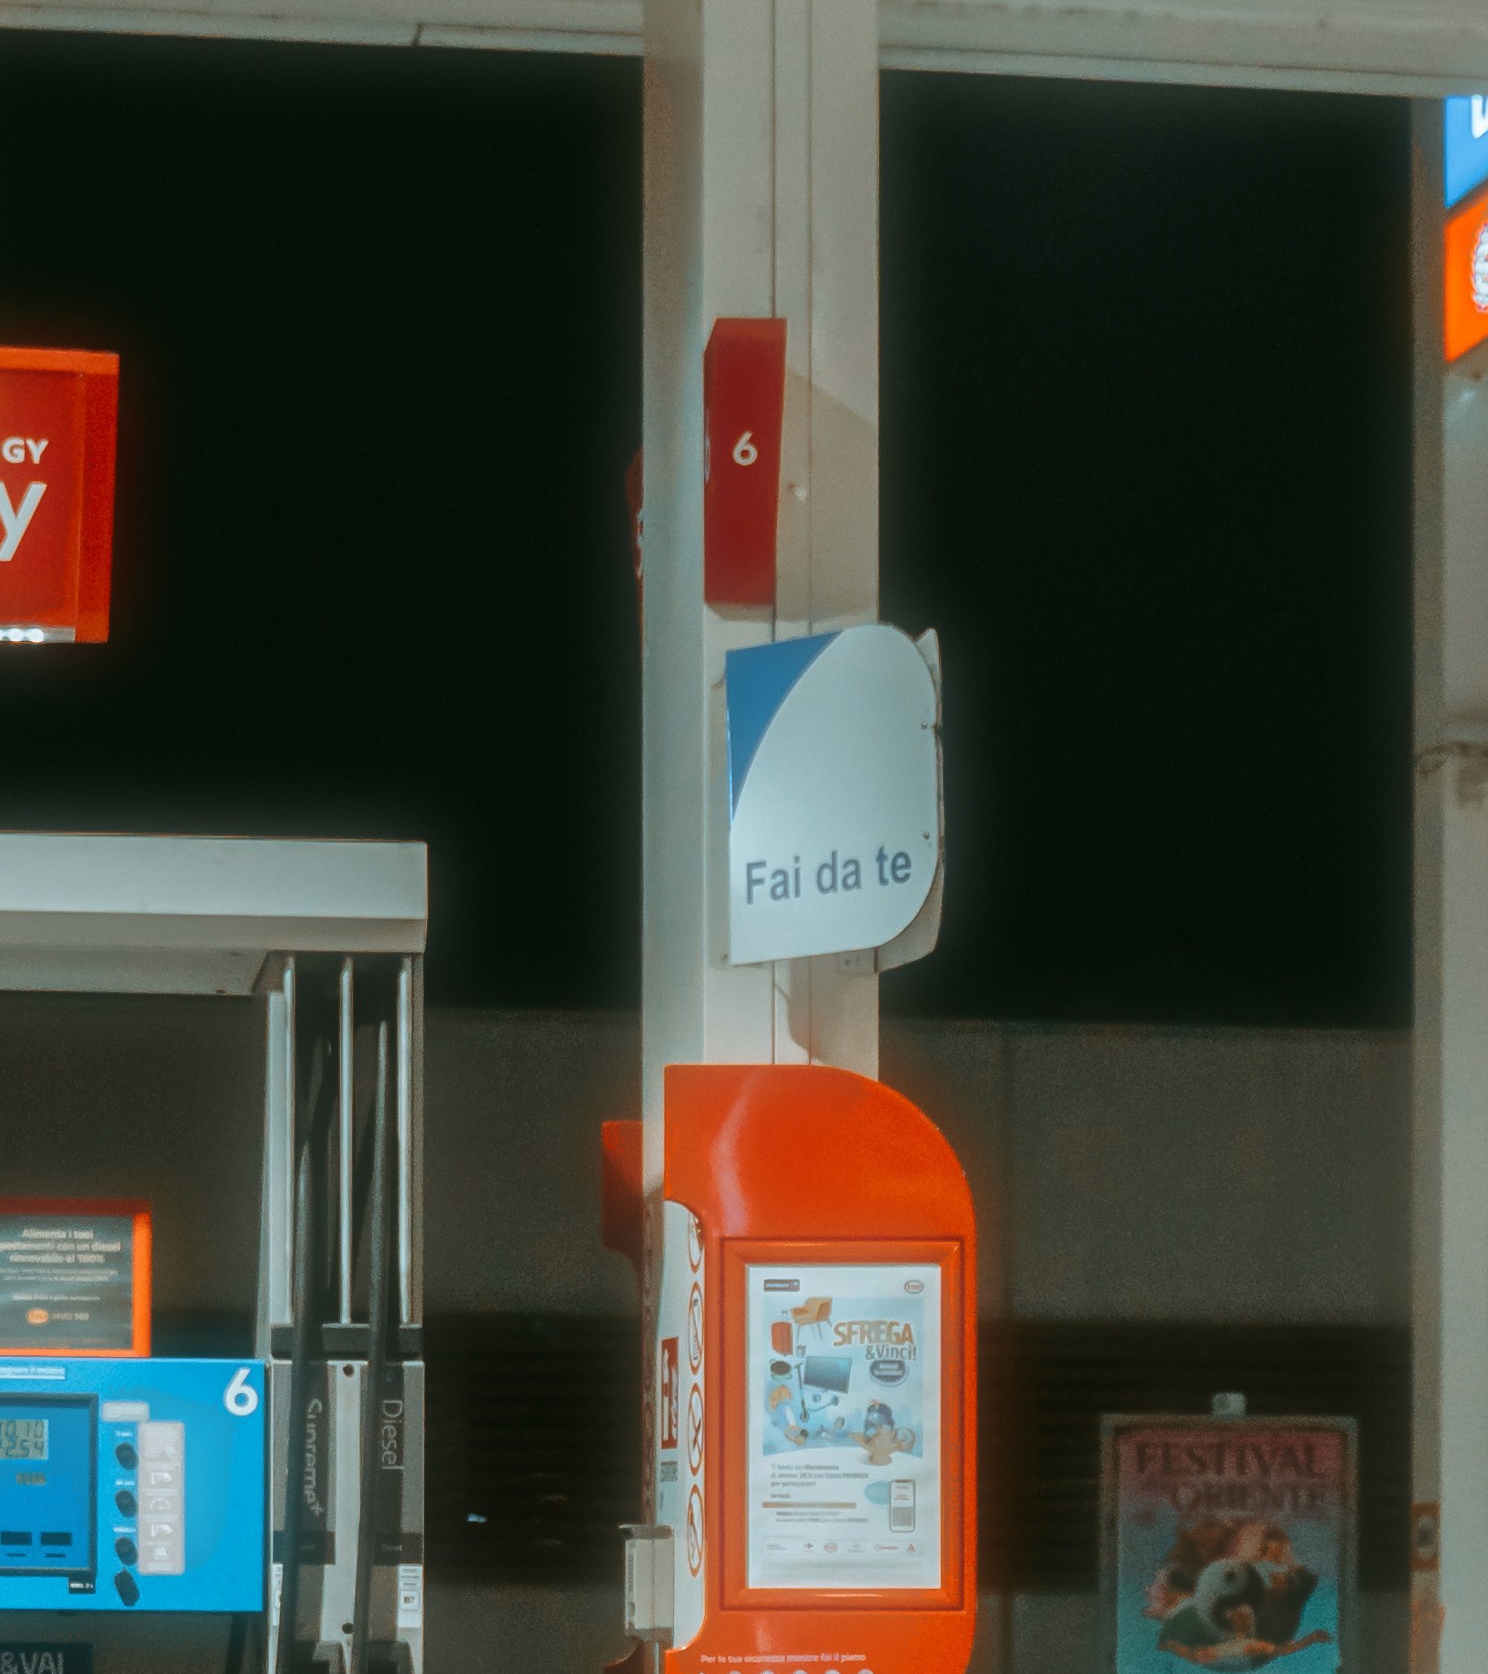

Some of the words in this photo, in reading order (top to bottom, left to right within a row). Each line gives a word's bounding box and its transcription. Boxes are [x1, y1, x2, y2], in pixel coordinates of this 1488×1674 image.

[732, 432, 758, 465] 6
[746, 856, 803, 904] Fai
[816, 850, 862, 894] da
[876, 846, 912, 886] te
[833, 1321, 914, 1346] SFREGA
[866, 1344, 917, 1361] &Vinci!
[223, 1368, 259, 1417] 6
[381, 1399, 405, 1470] Diesel
